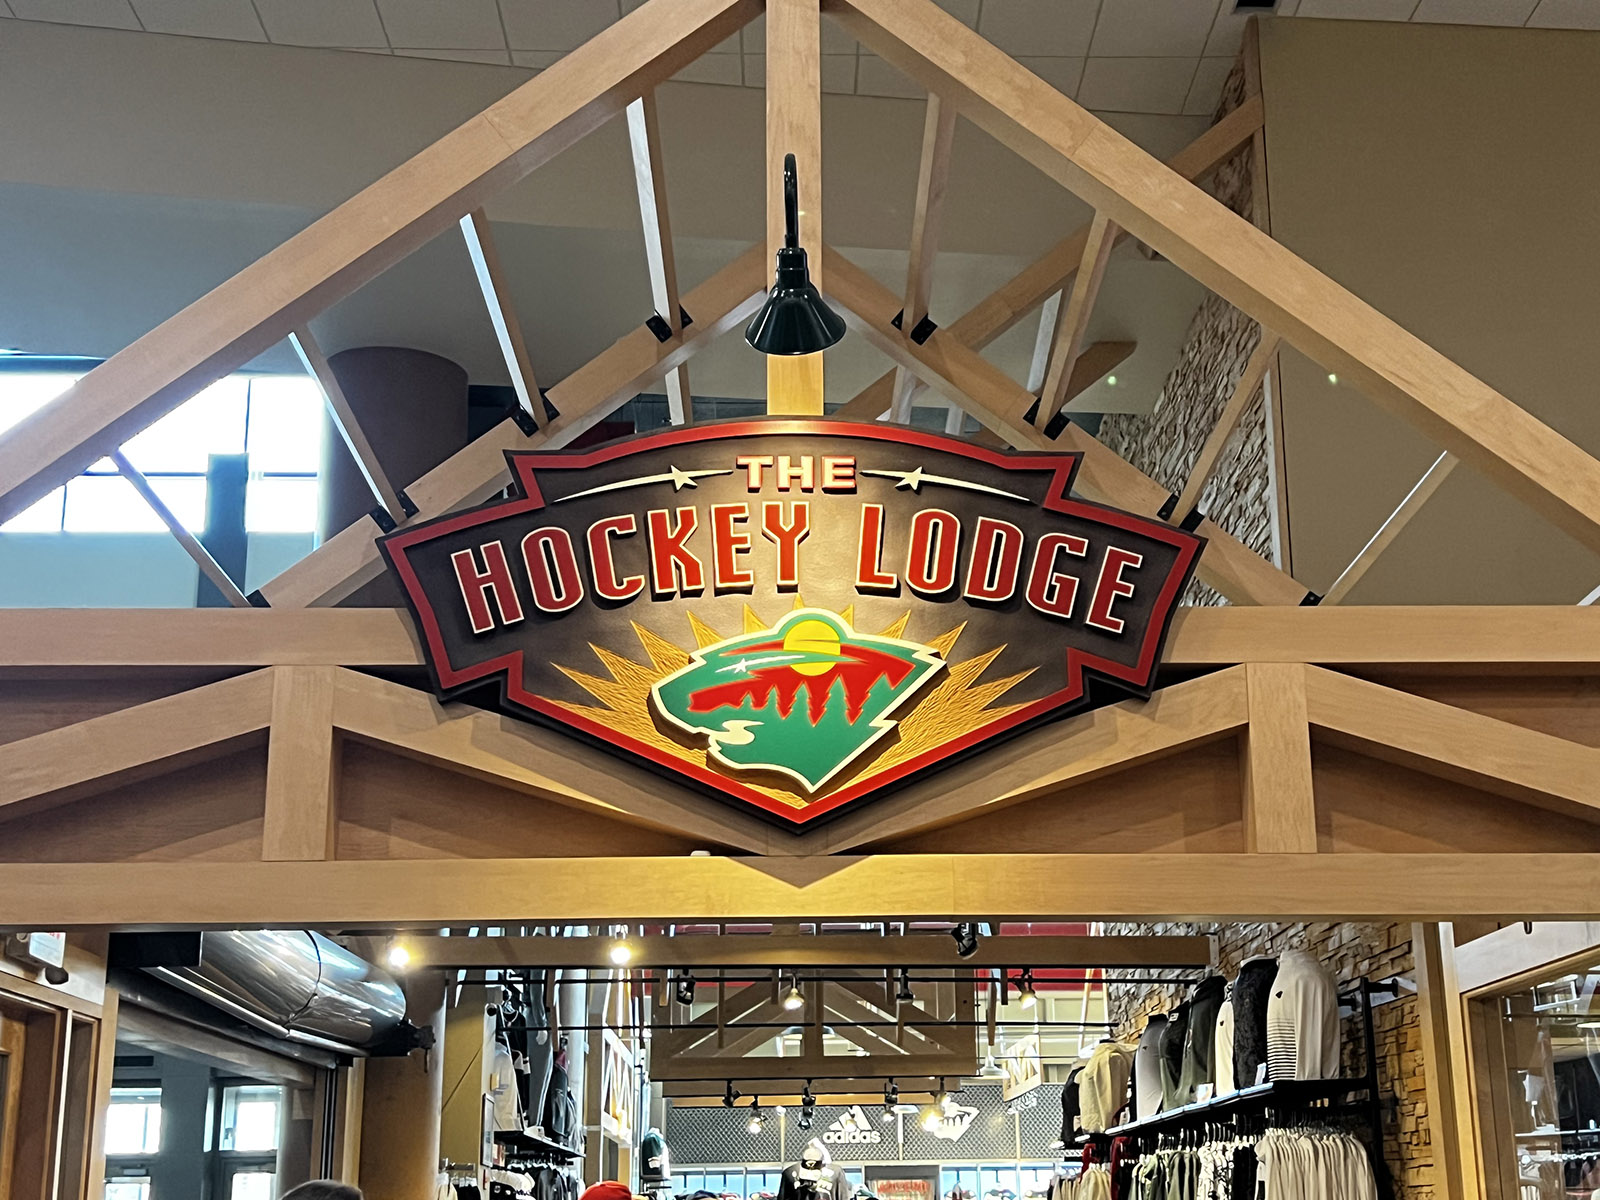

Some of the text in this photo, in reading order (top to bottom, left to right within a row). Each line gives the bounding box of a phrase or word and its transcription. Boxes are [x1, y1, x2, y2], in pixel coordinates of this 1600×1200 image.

[736, 455, 856, 492] THE
[450, 501, 1143, 634] HOCKEY LODGE
[822, 1128, 882, 1144] adidas
